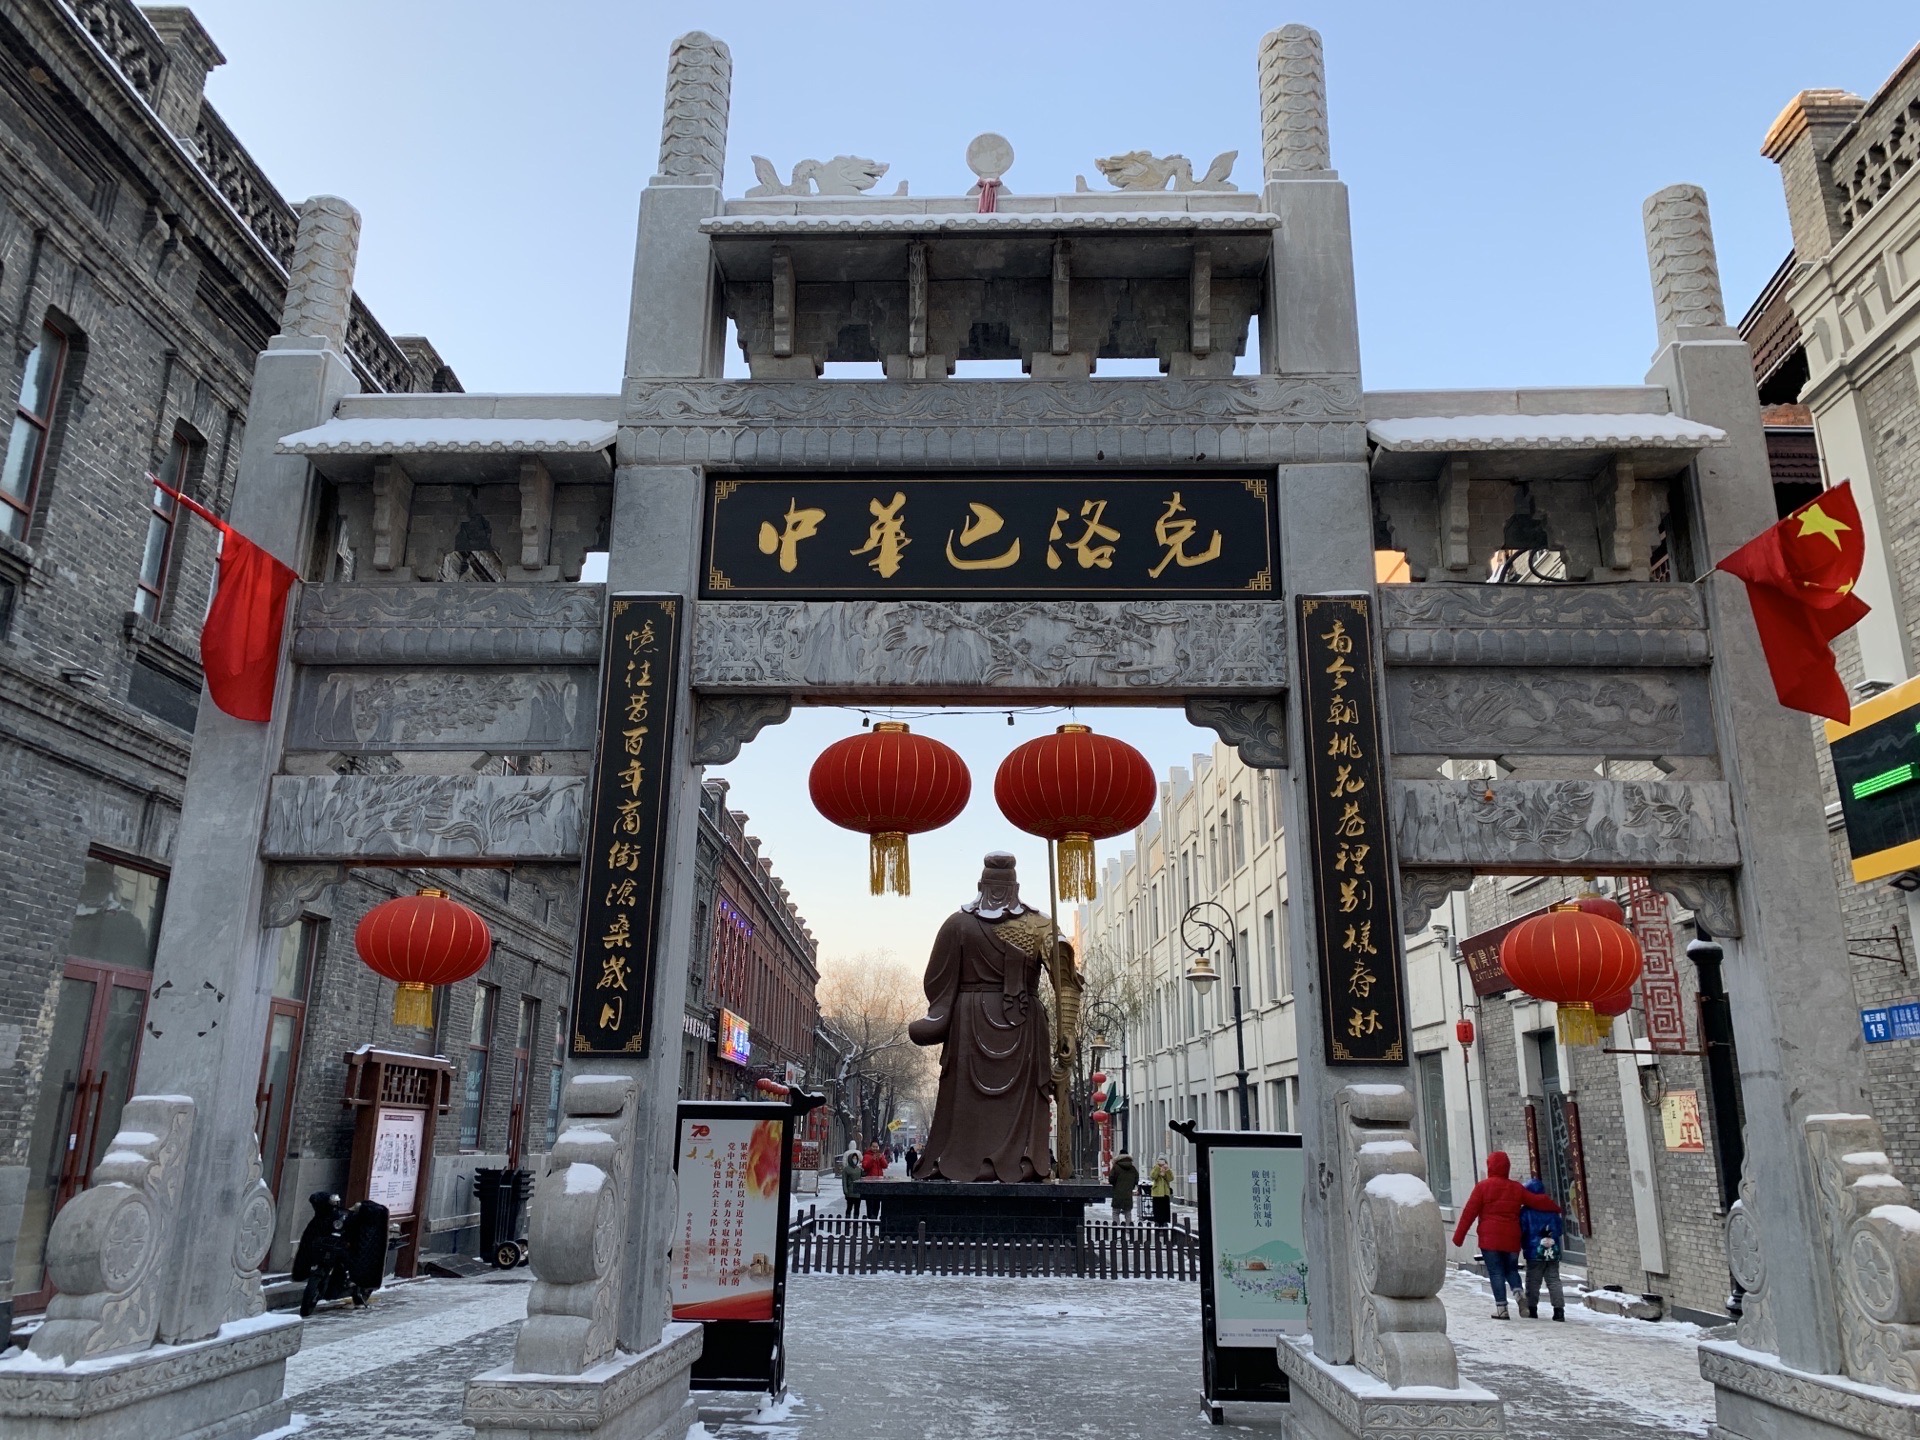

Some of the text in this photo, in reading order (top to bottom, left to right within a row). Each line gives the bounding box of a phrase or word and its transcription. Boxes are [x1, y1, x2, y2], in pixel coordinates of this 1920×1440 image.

[758, 491, 1222, 579] 中華巴洛克
[1475, 969, 1494, 982] CATTLE
[1870, 1023, 1885, 1038] 1号
[731, 1142, 748, 1287] 紧密团结在以习近平同志为核心的
[1262, 1169, 1273, 1228] 创全国文明城市
